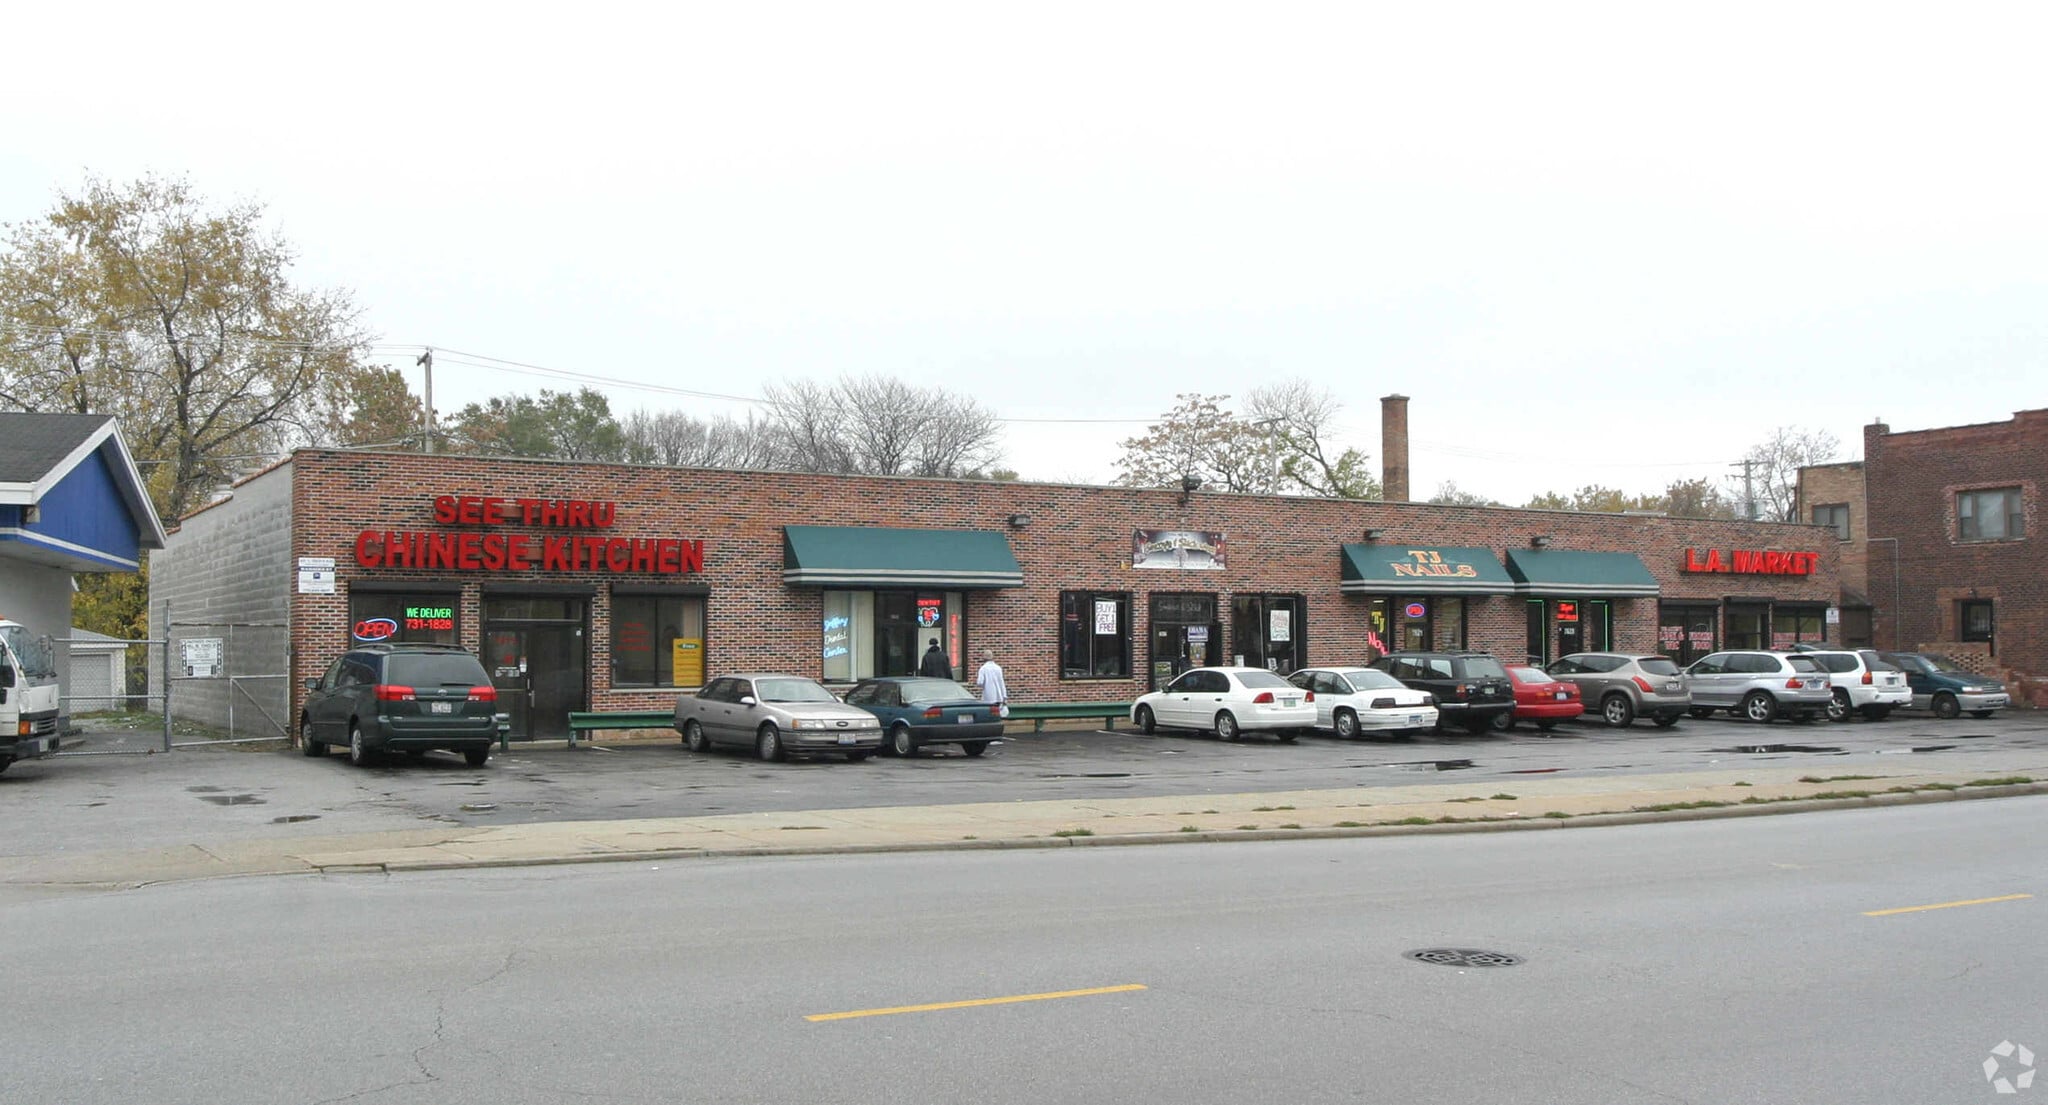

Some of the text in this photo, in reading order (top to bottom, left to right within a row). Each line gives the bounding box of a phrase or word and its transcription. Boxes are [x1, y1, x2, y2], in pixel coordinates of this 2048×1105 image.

[433, 495, 616, 528] SEE THRU
[354, 530, 705, 574] CHINESE KITCHEN
[1407, 550, 1441, 564] TJ
[1688, 549, 1818, 574] L.A. MARKET
[1390, 563, 1477, 578] NAILS
[406, 607, 452, 619] WE DELIVER
[1096, 602, 1111, 613] BUY
[354, 621, 394, 638] OPEN
[406, 619, 454, 630] 731-1828
[1099, 622, 1115, 632] FREE
